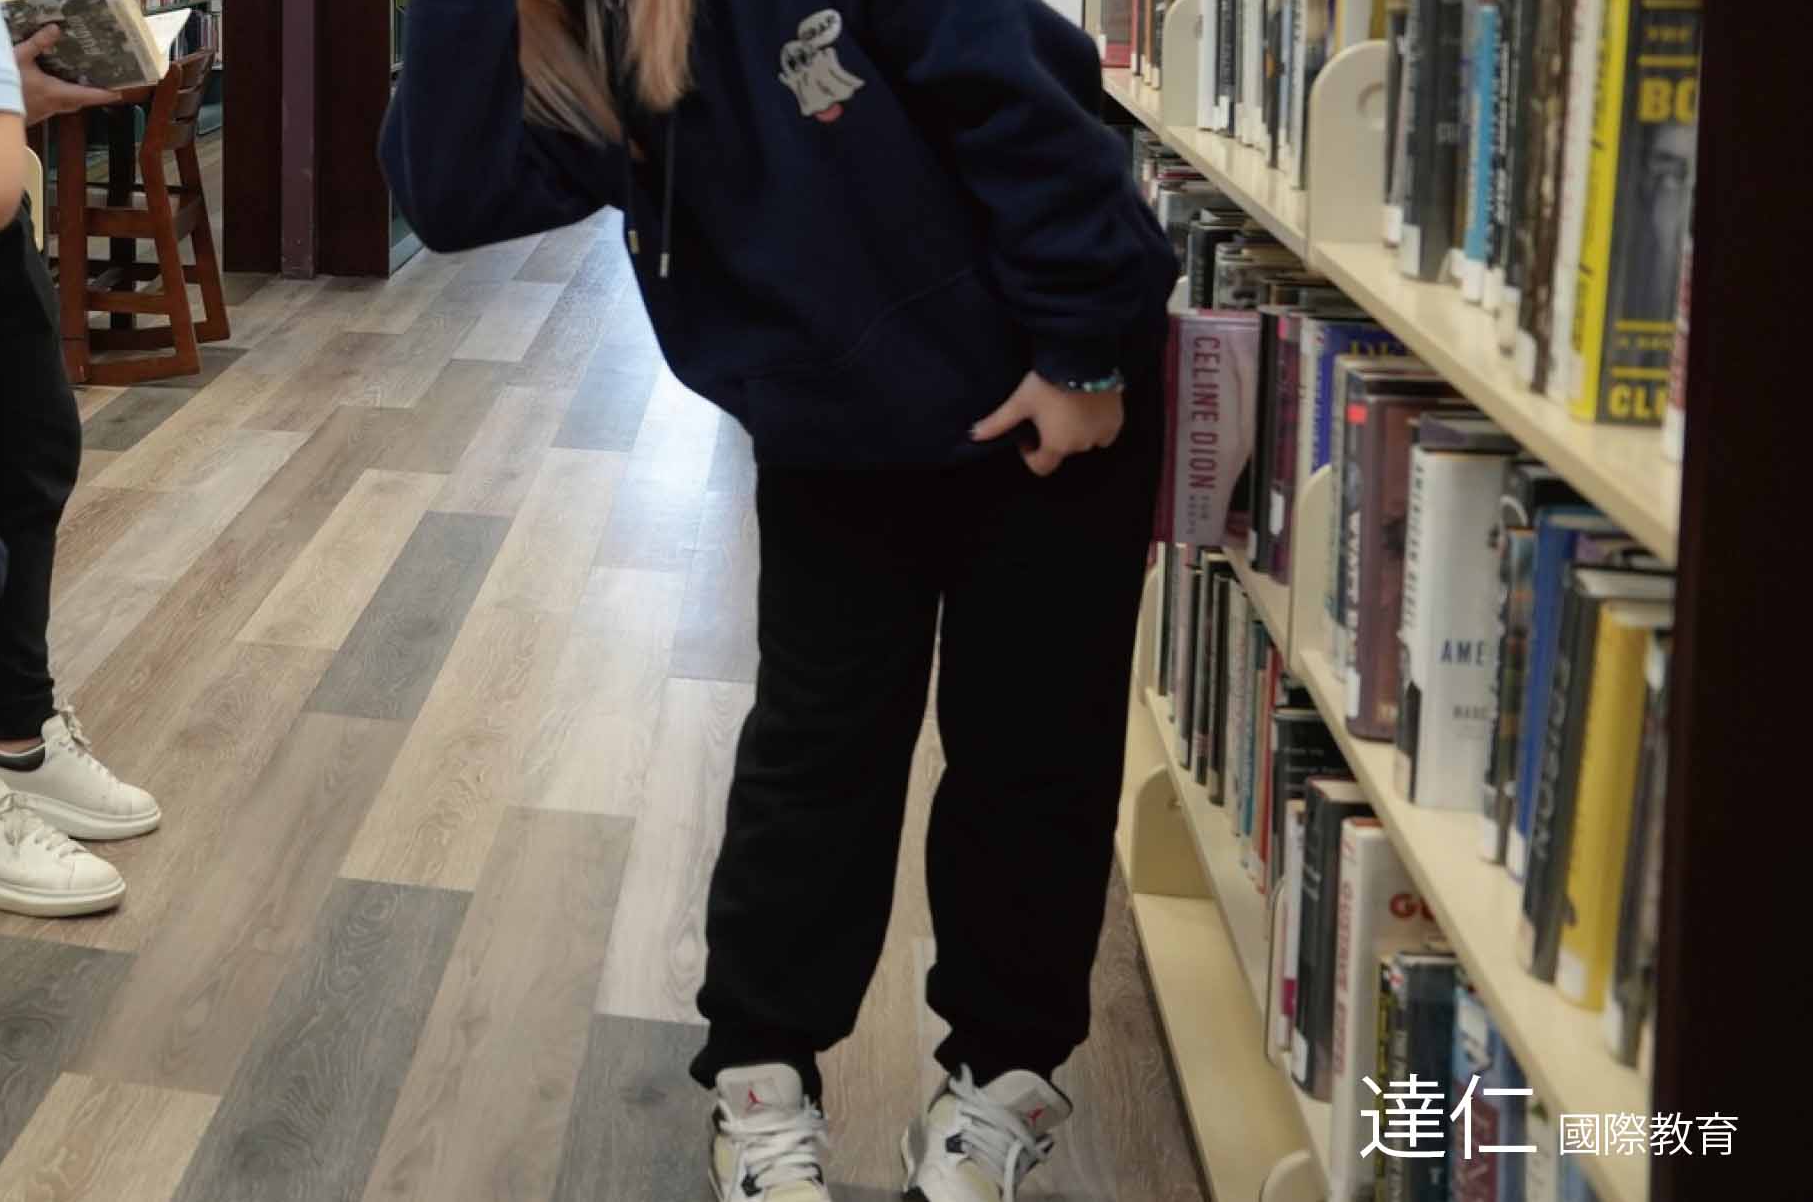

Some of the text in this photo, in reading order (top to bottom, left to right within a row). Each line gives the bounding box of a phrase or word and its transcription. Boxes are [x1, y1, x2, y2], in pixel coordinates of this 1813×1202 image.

[1189, 335, 1220, 490] CELINE DION
[1440, 639, 1486, 668] AME
